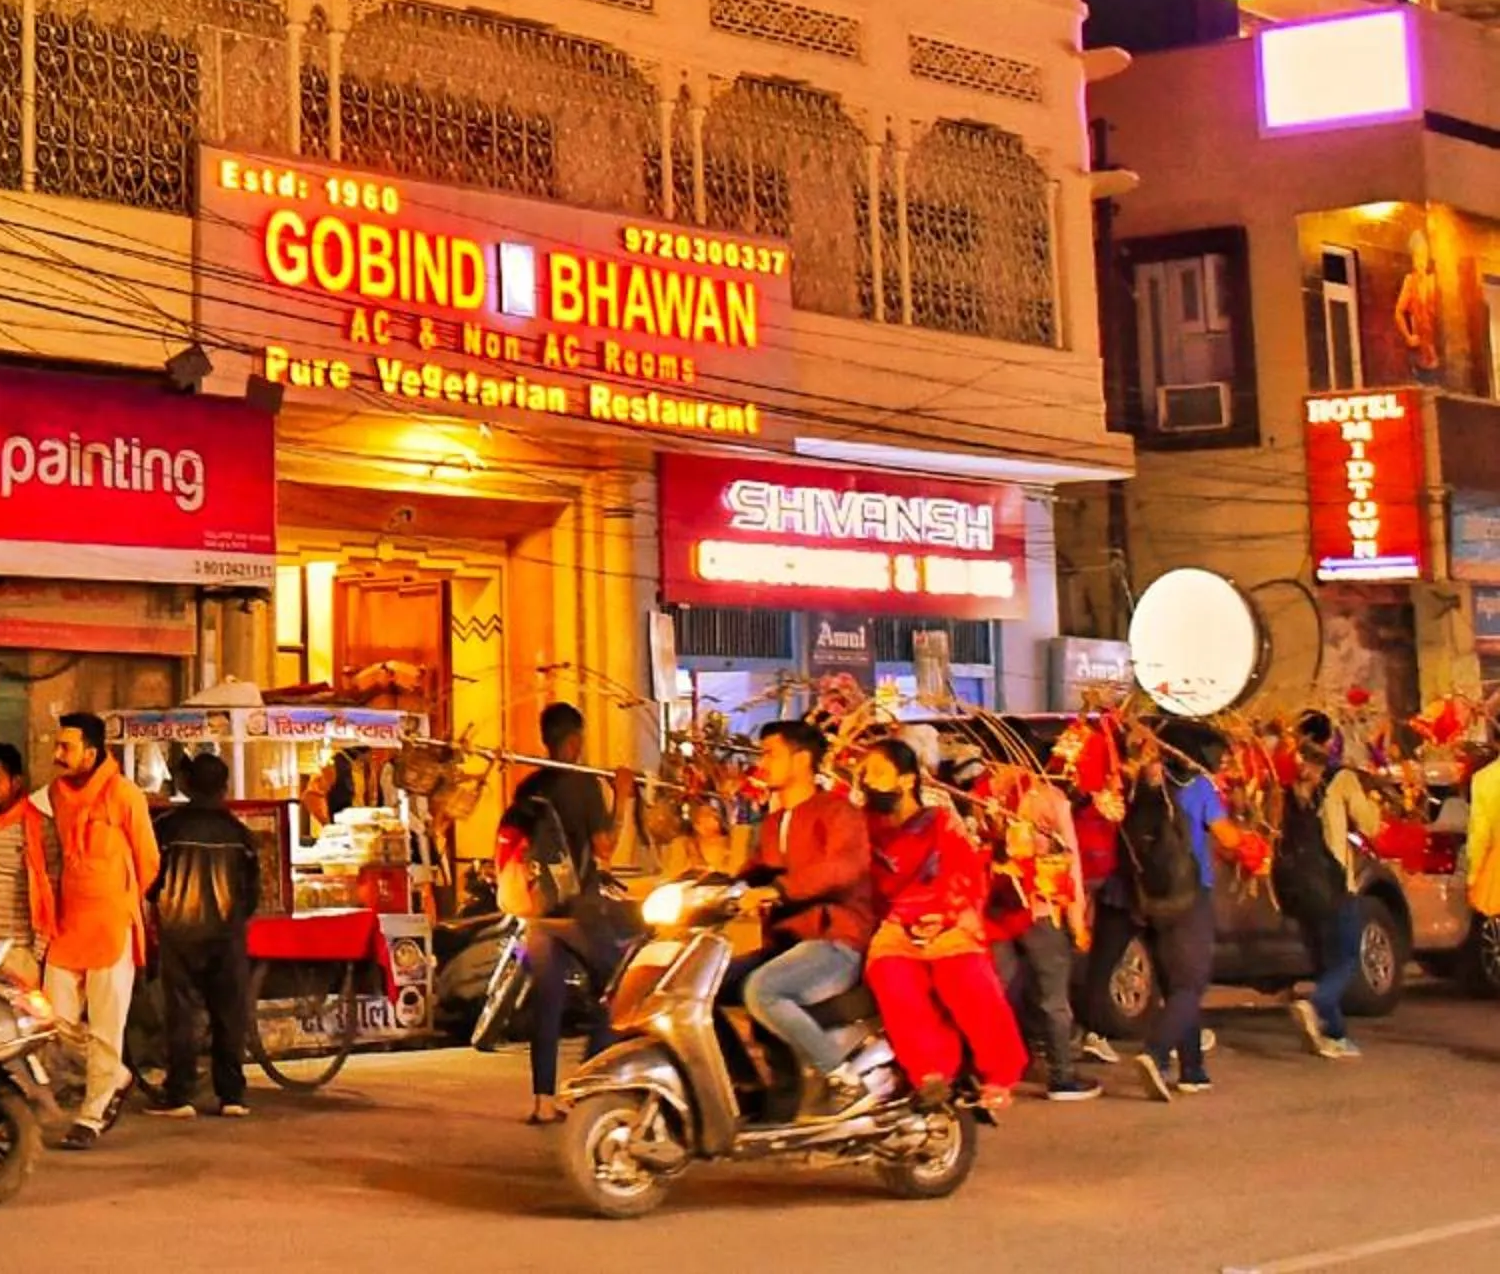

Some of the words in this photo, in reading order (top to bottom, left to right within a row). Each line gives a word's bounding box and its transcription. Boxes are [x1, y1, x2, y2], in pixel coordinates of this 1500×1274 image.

[220, 159, 308, 199] Estd:
[326, 177, 399, 214] 1960
[265, 209, 485, 310] GOBIND
[549, 252, 757, 346] BHAWAN
[350, 308, 390, 344] AC
[419, 317, 436, 350] &
[463, 323, 520, 360] Non
[543, 333, 580, 367] AC
[604, 340, 695, 382] Rooms
[265, 346, 350, 389] Pure
[377, 357, 567, 413] Vegetarian
[590, 382, 759, 434] Restaurant
[1306, 394, 1405, 423] HOTEL
[0, 432, 205, 512] painting
[725, 479, 994, 551] SHIVANSH
[817, 621, 866, 649] Amul
